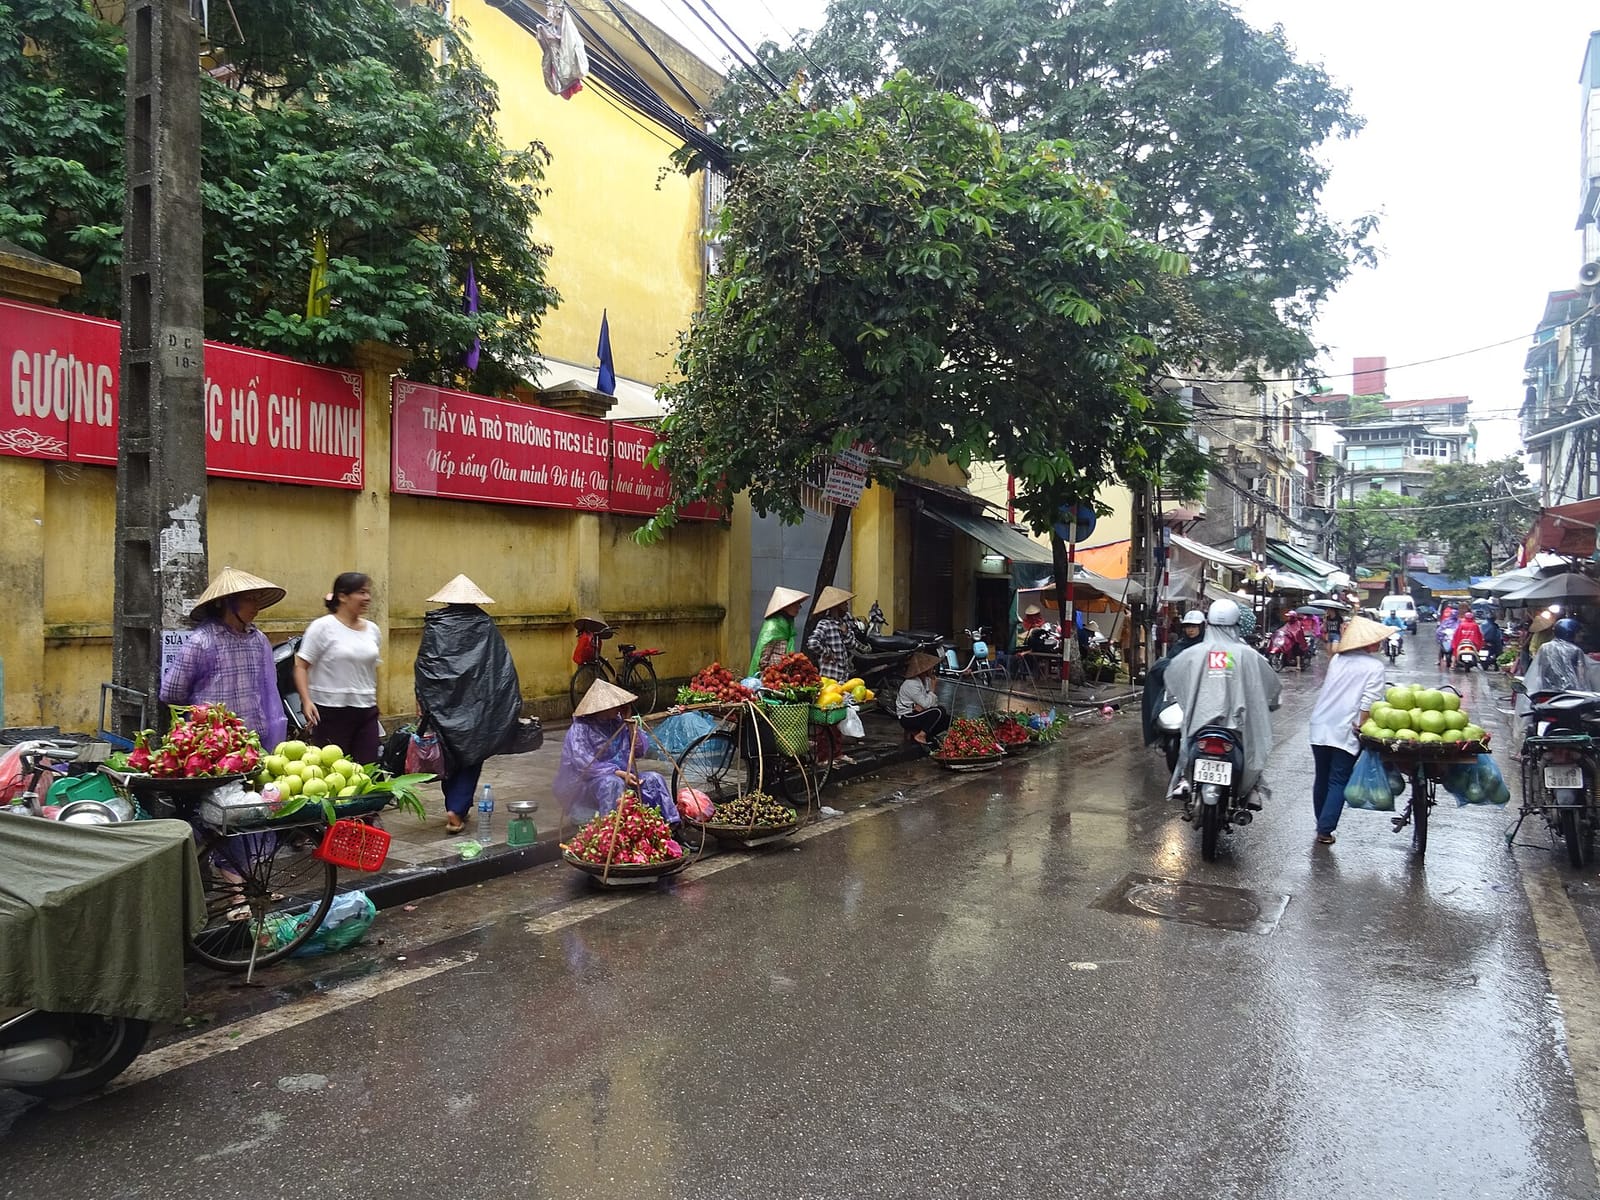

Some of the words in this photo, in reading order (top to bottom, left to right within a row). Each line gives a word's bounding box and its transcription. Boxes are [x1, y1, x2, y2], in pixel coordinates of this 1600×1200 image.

[11, 348, 113, 427] GƯƠNG
[230, 375, 260, 446] HỒ
[267, 387, 301, 450] CHÍ
[309, 400, 360, 458] MINH
[422, 403, 457, 434] THẦY
[460, 409, 477, 437] VÀ
[479, 414, 502, 441] TRÒ
[505, 420, 551, 449] TRƯỜNG
[553, 430, 580, 453] THCS
[582, 431, 593, 455] LÊ
[617, 437, 646, 463] QUYẾT
[426, 448, 455, 479] Nếp
[458, 453, 488, 484] sống
[520, 463, 549, 486] minh
[550, 465, 568, 487] Đô
[616, 473, 633, 495] hoá
